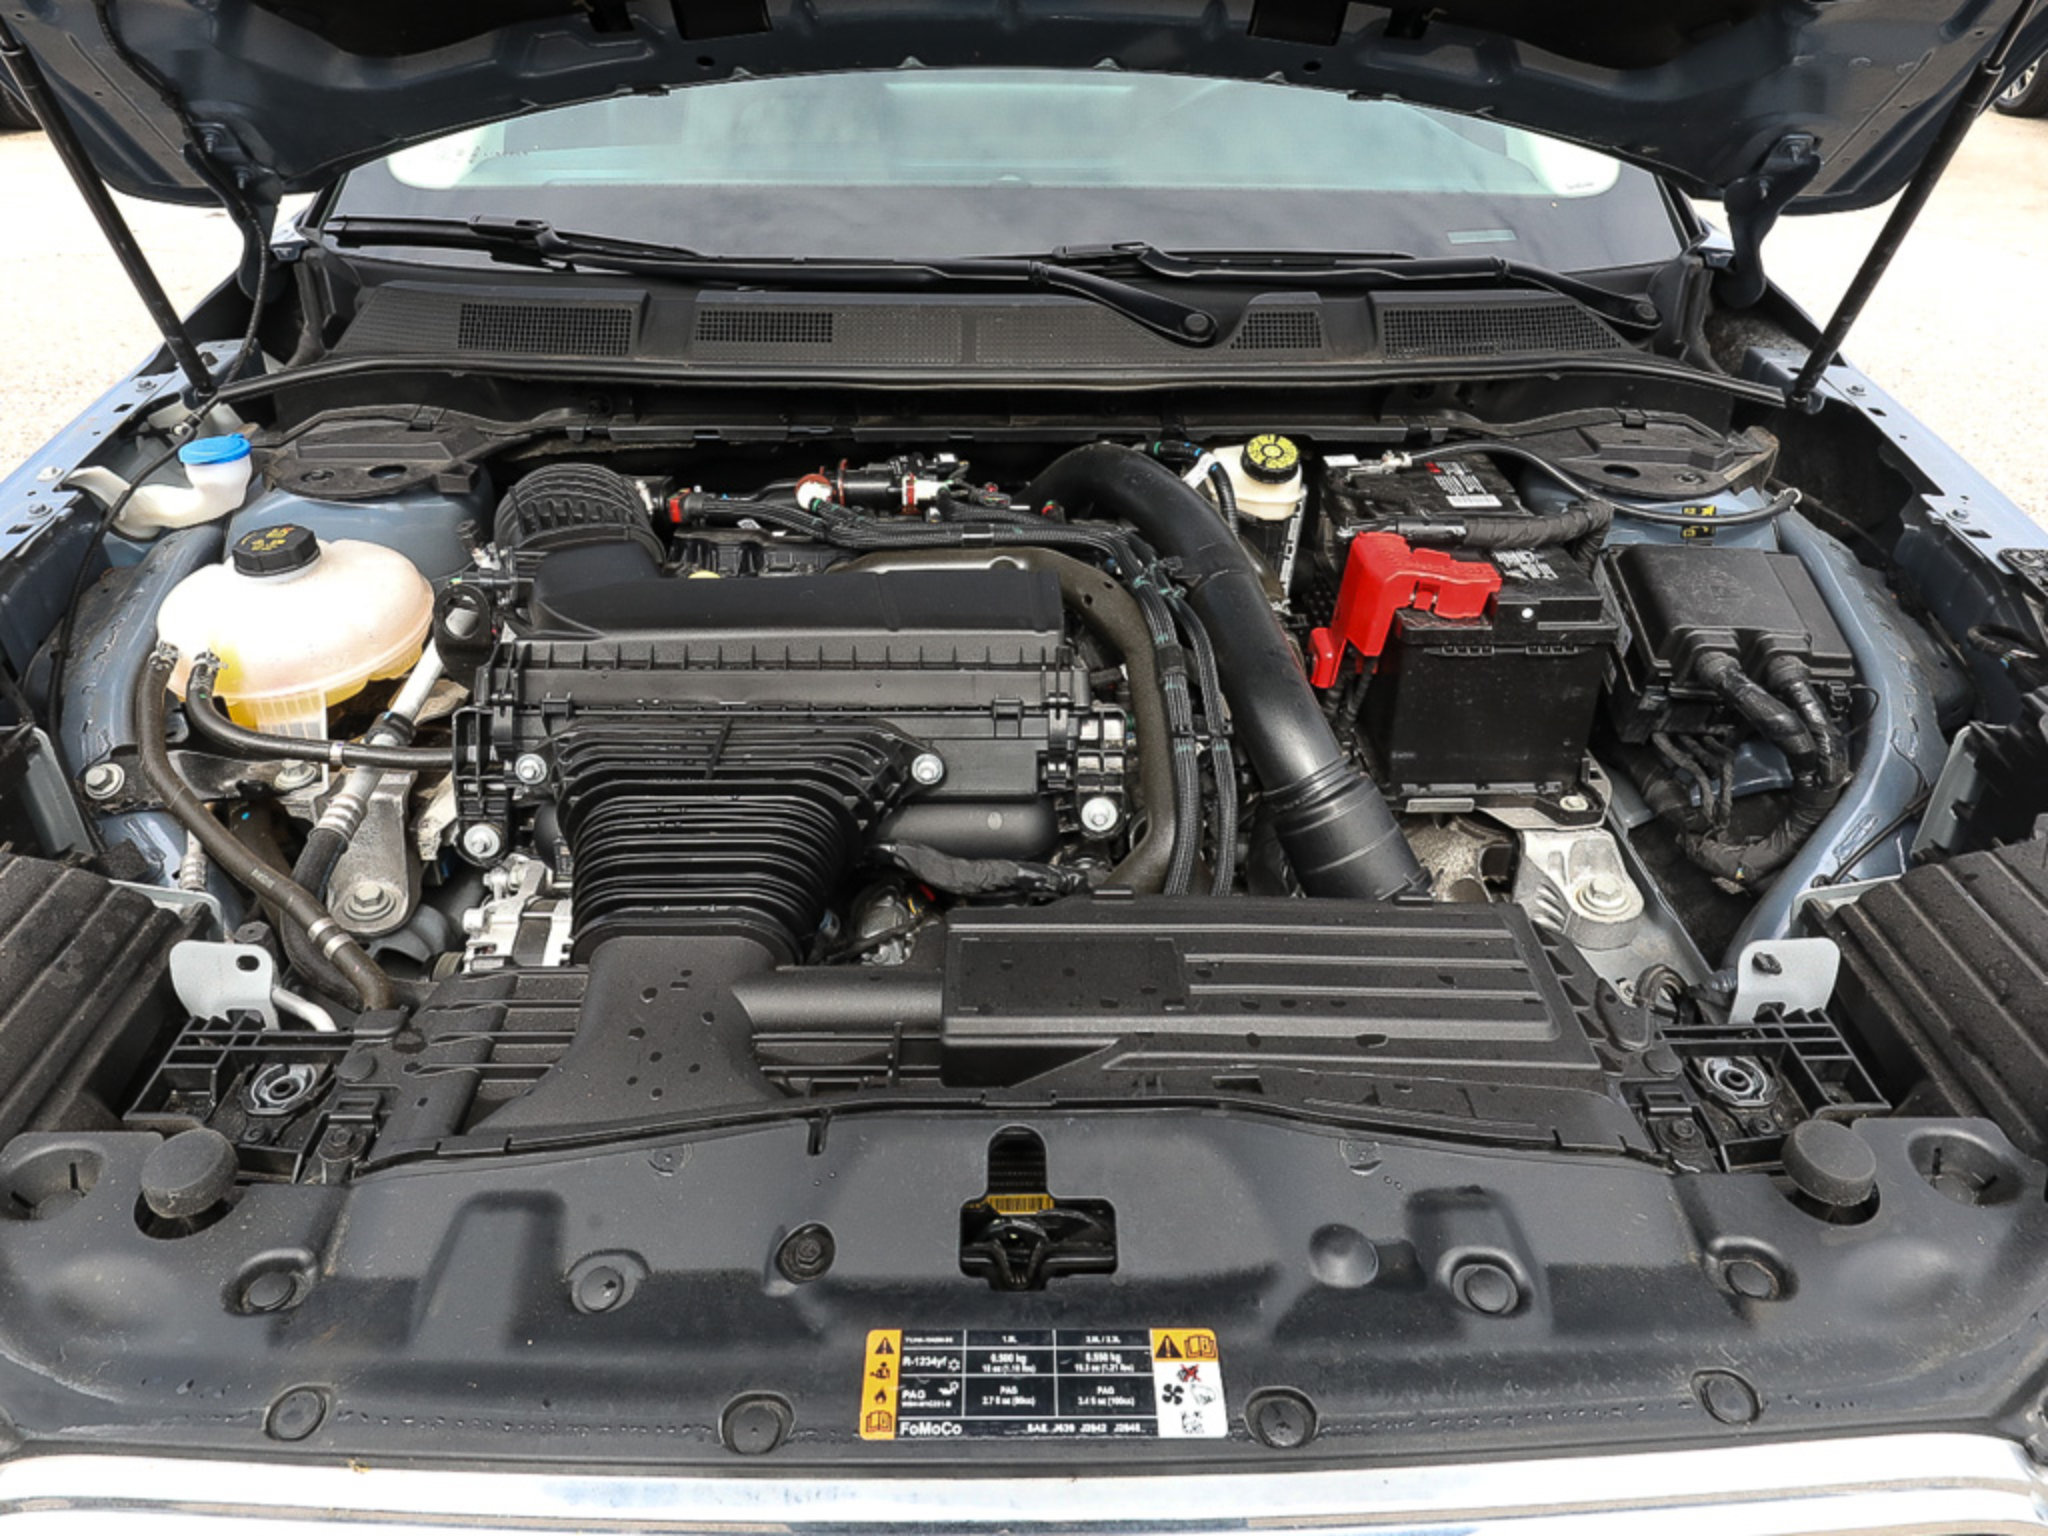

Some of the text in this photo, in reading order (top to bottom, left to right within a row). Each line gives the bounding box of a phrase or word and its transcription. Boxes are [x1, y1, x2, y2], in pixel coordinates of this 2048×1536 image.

[902, 1356, 947, 1369] R-1234yf
[1015, 1352, 1027, 1365] kg
[1109, 1352, 1122, 1364] kg
[902, 1389, 926, 1400] PAG
[1000, 1385, 1018, 1395] PAG
[1097, 1385, 1115, 1395] PAG
[899, 1421, 962, 1436] FoMoCo
